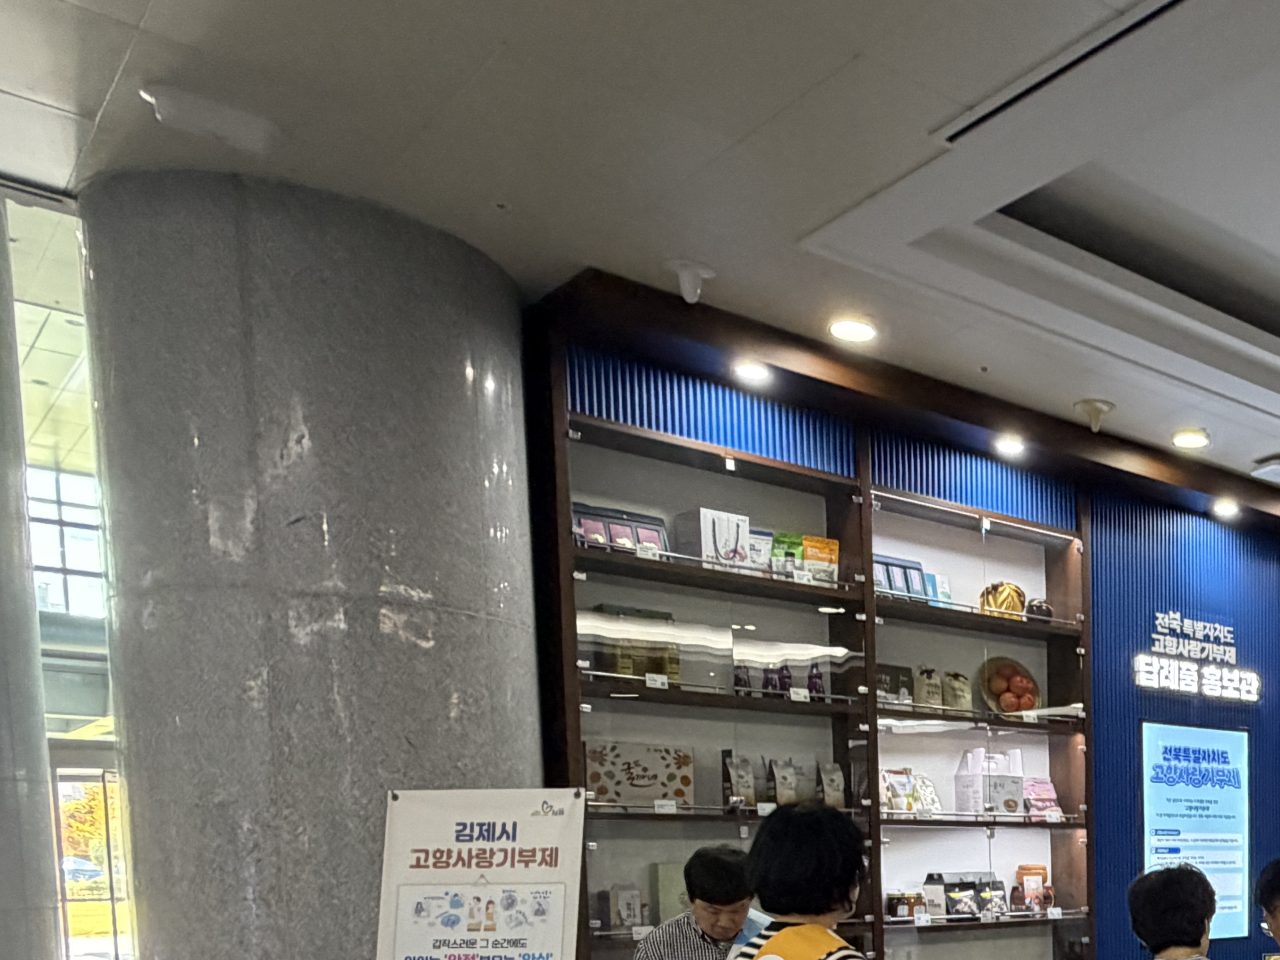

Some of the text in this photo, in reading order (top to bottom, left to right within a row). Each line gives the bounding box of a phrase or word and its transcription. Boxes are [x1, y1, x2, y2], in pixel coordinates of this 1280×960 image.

[1151, 633, 1237, 665] 고향사랑기부제
[1134, 653, 1261, 702] 답례품 홍보관
[1162, 745, 1231, 766] 전북특별자치도
[1150, 763, 1241, 789] 고향사랑기부제
[454, 820, 518, 843] 김제시
[408, 845, 560, 870] 고향사랑기부제
[432, 937, 528, 950] 갑작스러운 그 순간에도
